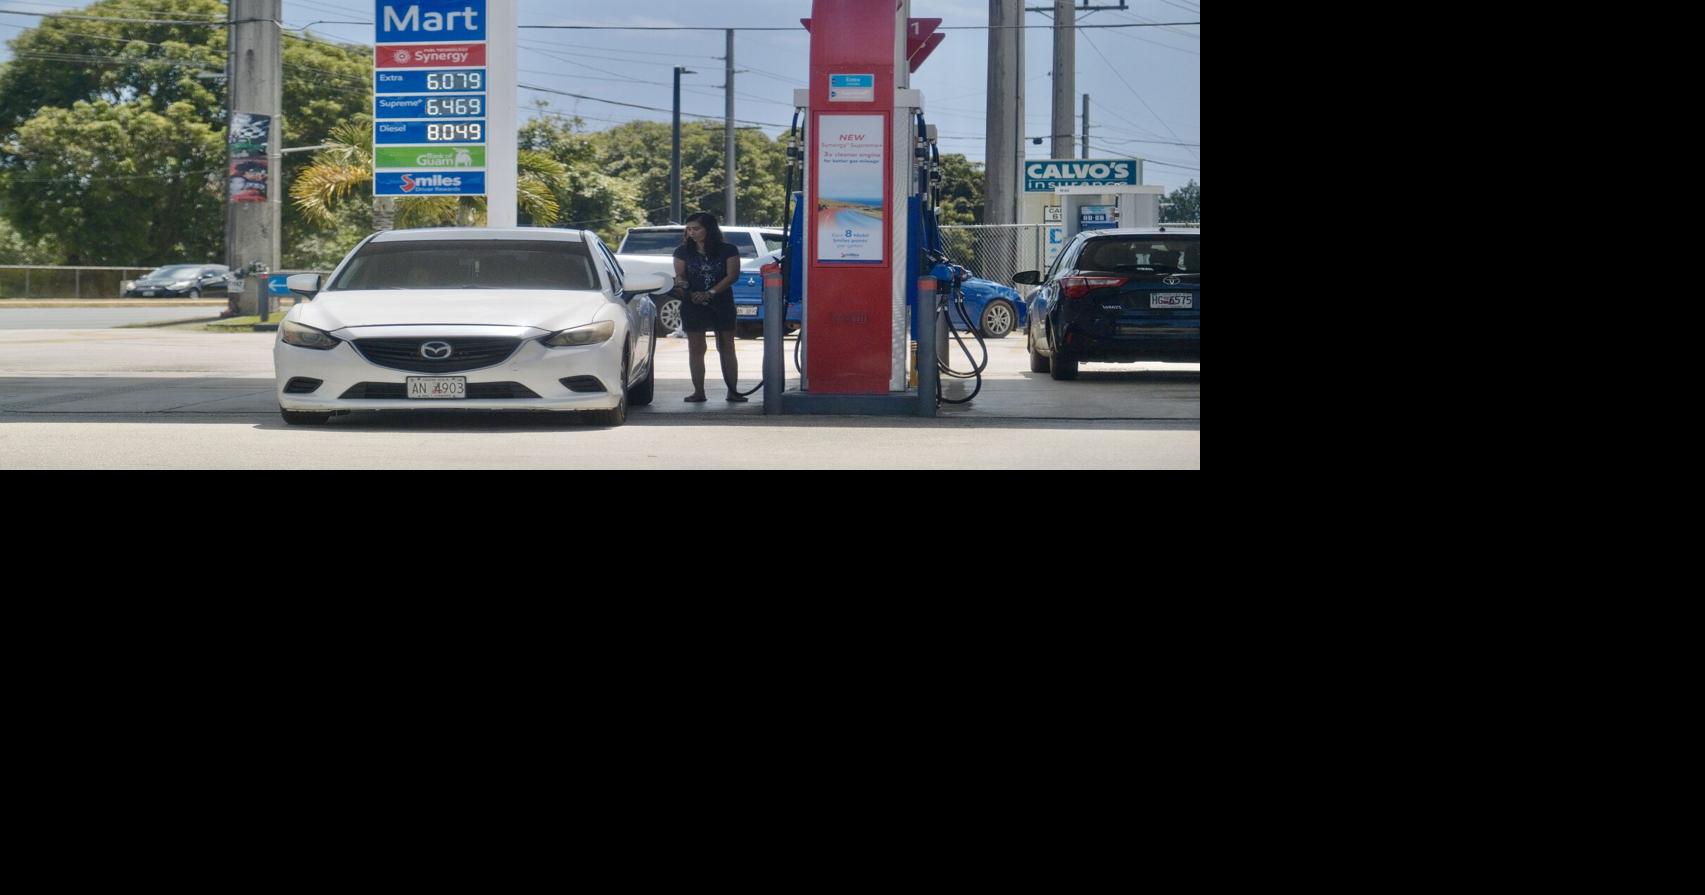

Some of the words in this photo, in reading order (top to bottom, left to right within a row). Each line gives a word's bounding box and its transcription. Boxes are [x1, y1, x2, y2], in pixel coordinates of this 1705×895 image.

[383, 5, 478, 32] Mart
[911, 22, 919, 35] 1
[415, 50, 468, 63] Synergy
[380, 74, 403, 82] Extra
[427, 73, 481, 90] 6.079
[427, 99, 481, 116] 6.469
[379, 125, 406, 133] Diesel
[427, 124, 481, 141] 8.049
[416, 155, 454, 166] Guam
[1027, 162, 1130, 179] CALVO'S
[400, 174, 462, 193] Smiles
[845, 229, 852, 238] 8
[412, 382, 427, 394] AN
[433, 382, 464, 393] 4903
